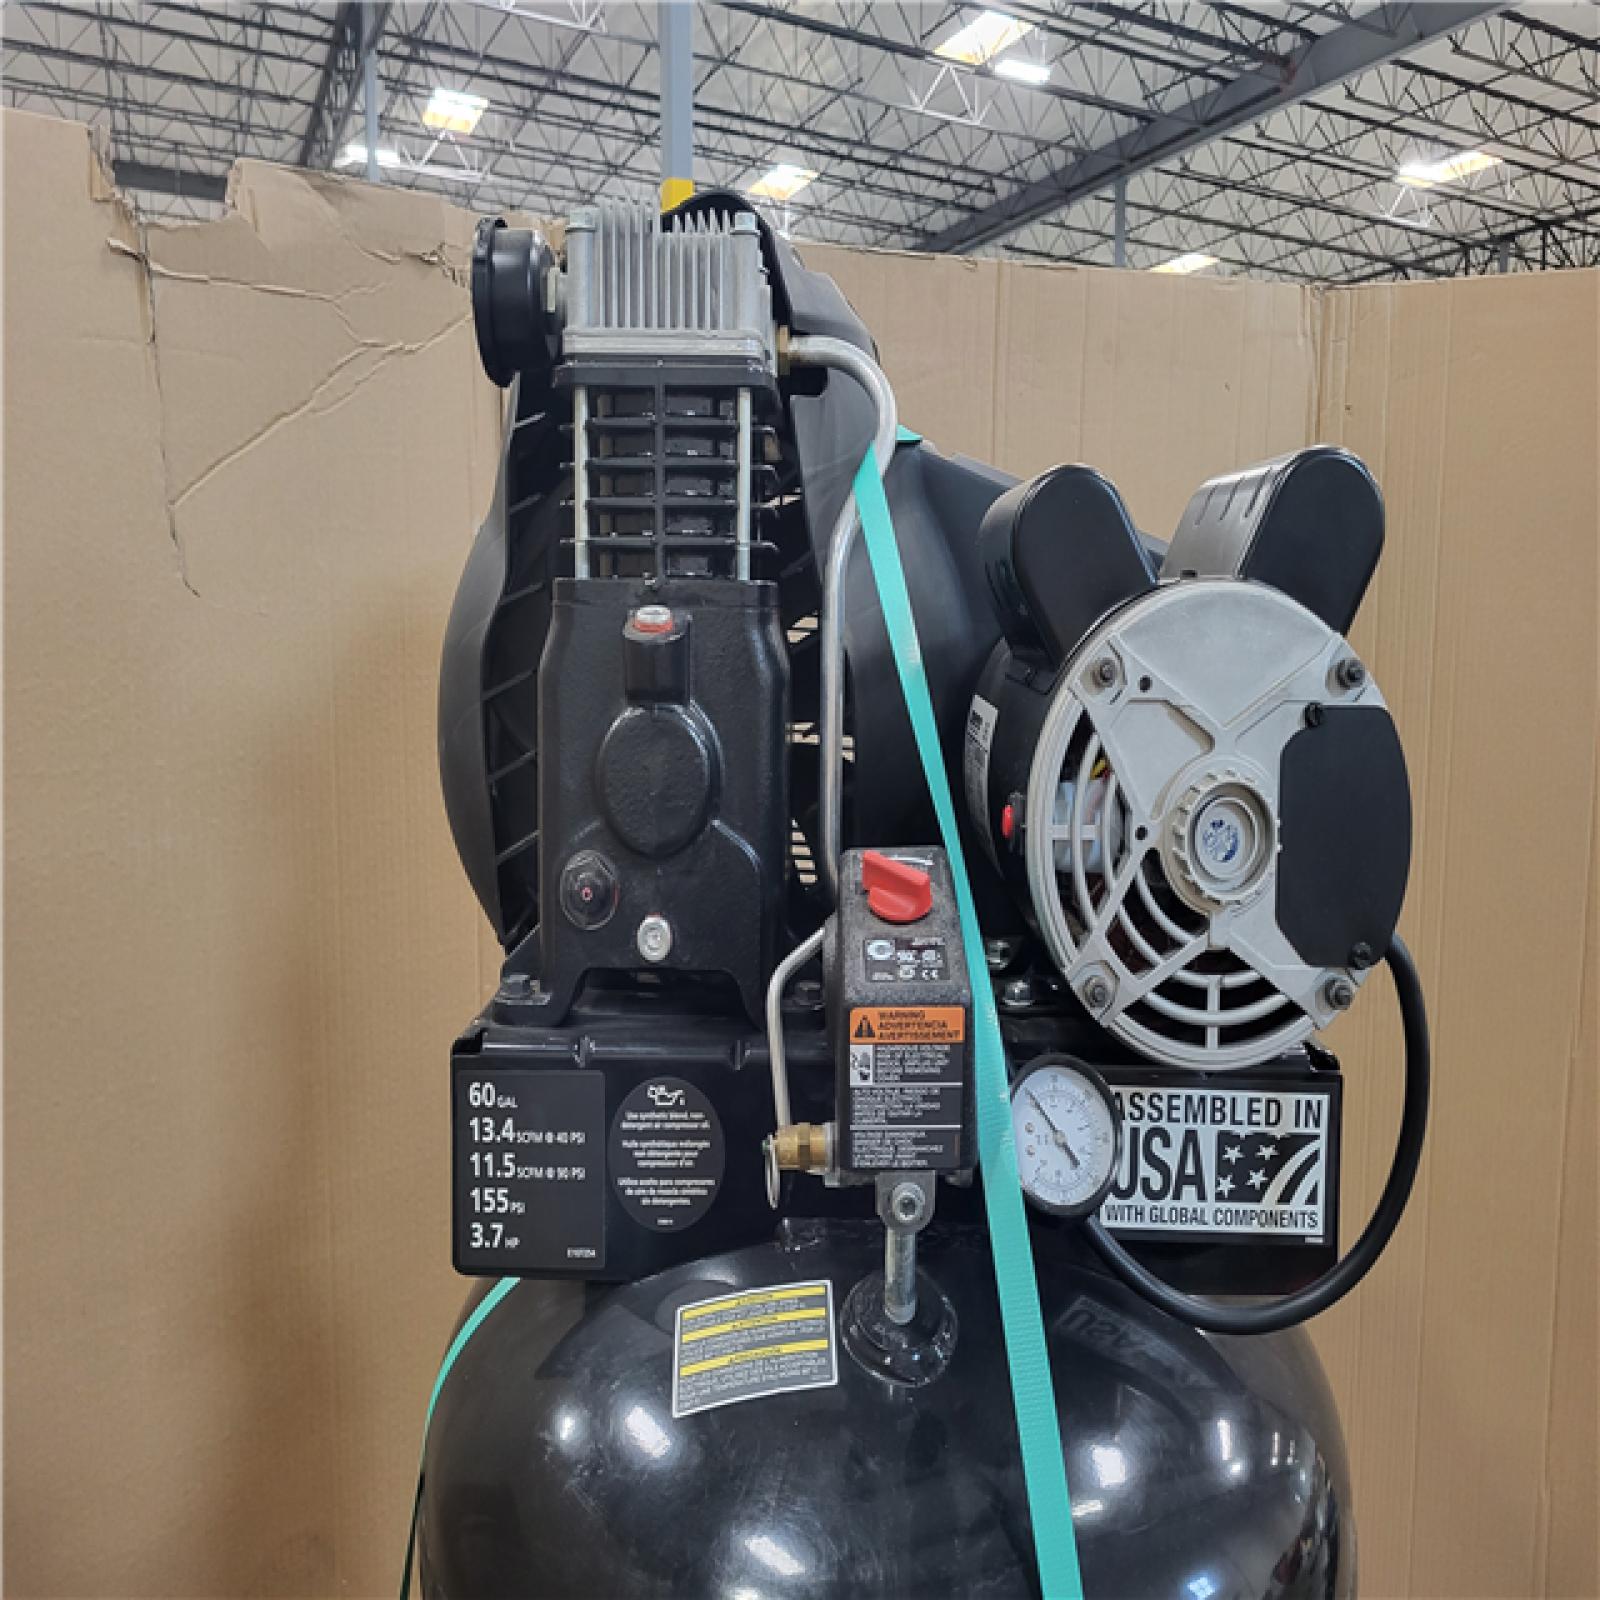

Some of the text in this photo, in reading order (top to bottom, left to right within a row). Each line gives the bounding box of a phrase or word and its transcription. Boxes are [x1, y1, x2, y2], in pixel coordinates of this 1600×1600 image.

[469, 1082, 518, 1109] 60 GAL
[1294, 1098, 1321, 1129] IN
[469, 1117, 515, 1143] 13.4
[571, 1131, 586, 1144] PSI
[469, 1152, 516, 1178] 11.5
[571, 1166, 586, 1179] PSI
[1106, 1126, 1208, 1202] USA
[469, 1187, 525, 1214] 155 PSI
[1103, 1203, 1319, 1230] WITH GLOBAL COMPONENTS
[470, 1222, 504, 1249] 3.7
